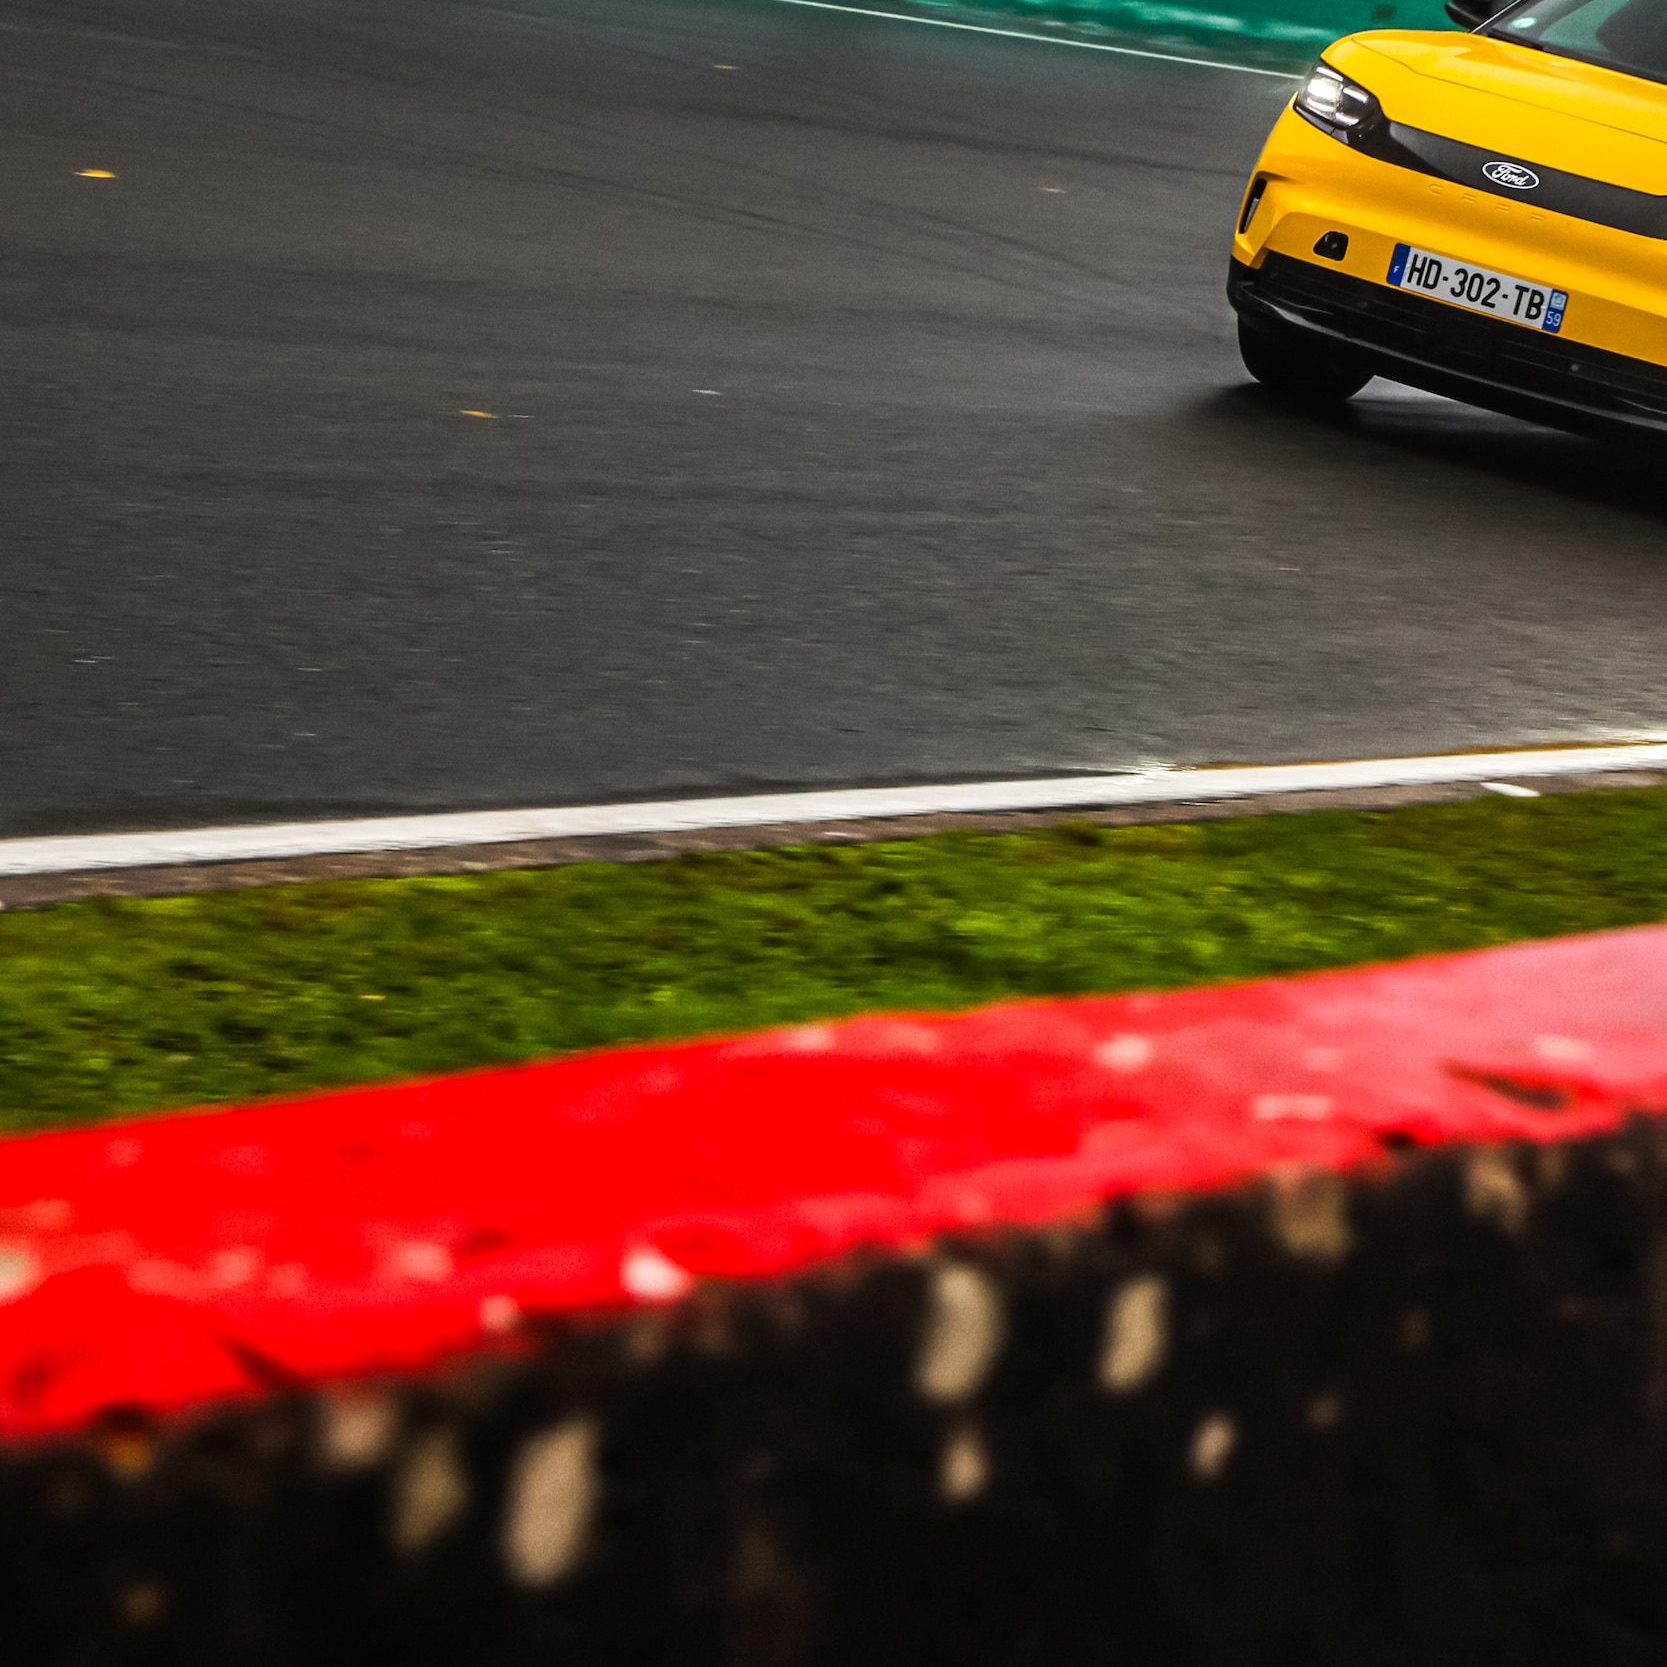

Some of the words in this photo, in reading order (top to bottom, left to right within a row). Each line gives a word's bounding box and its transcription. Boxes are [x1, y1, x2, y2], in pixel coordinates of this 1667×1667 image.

[1491, 164, 1530, 186] Ford
[1407, 253, 1545, 320] HD-302-TB
[1545, 310, 1562, 327] 59
